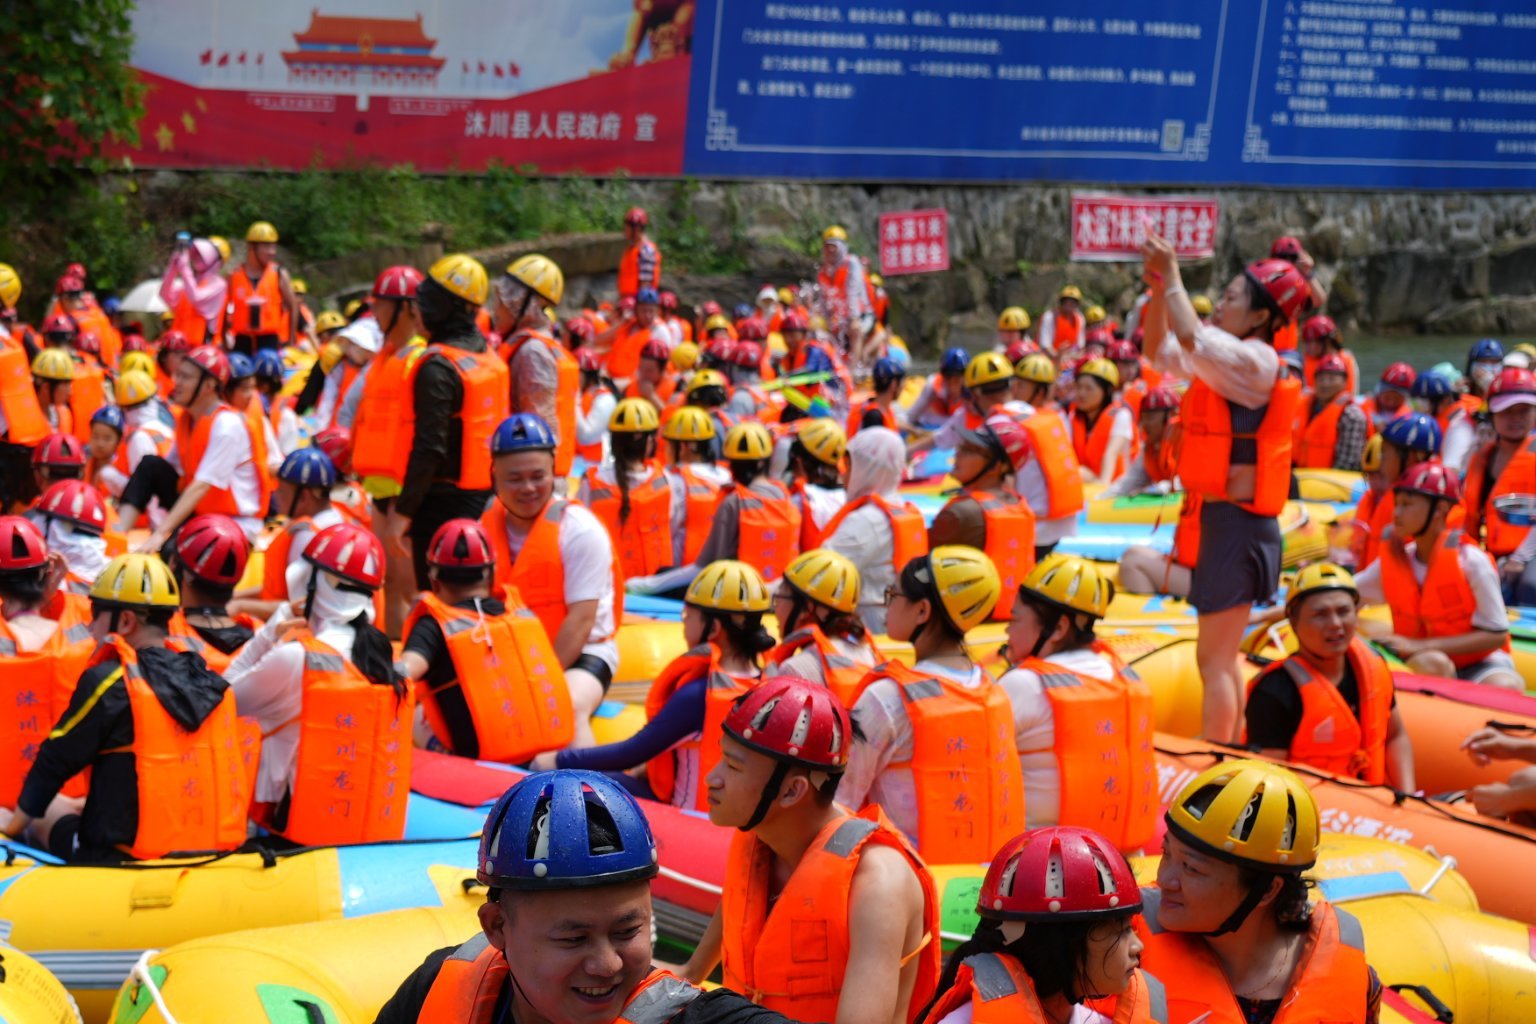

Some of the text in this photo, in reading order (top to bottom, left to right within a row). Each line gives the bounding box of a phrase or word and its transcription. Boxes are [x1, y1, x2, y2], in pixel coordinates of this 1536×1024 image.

[465, 110, 621, 141] 沐川县人民政府
[884, 216, 942, 241] 水深1米
[884, 242, 942, 268] 注意安全
